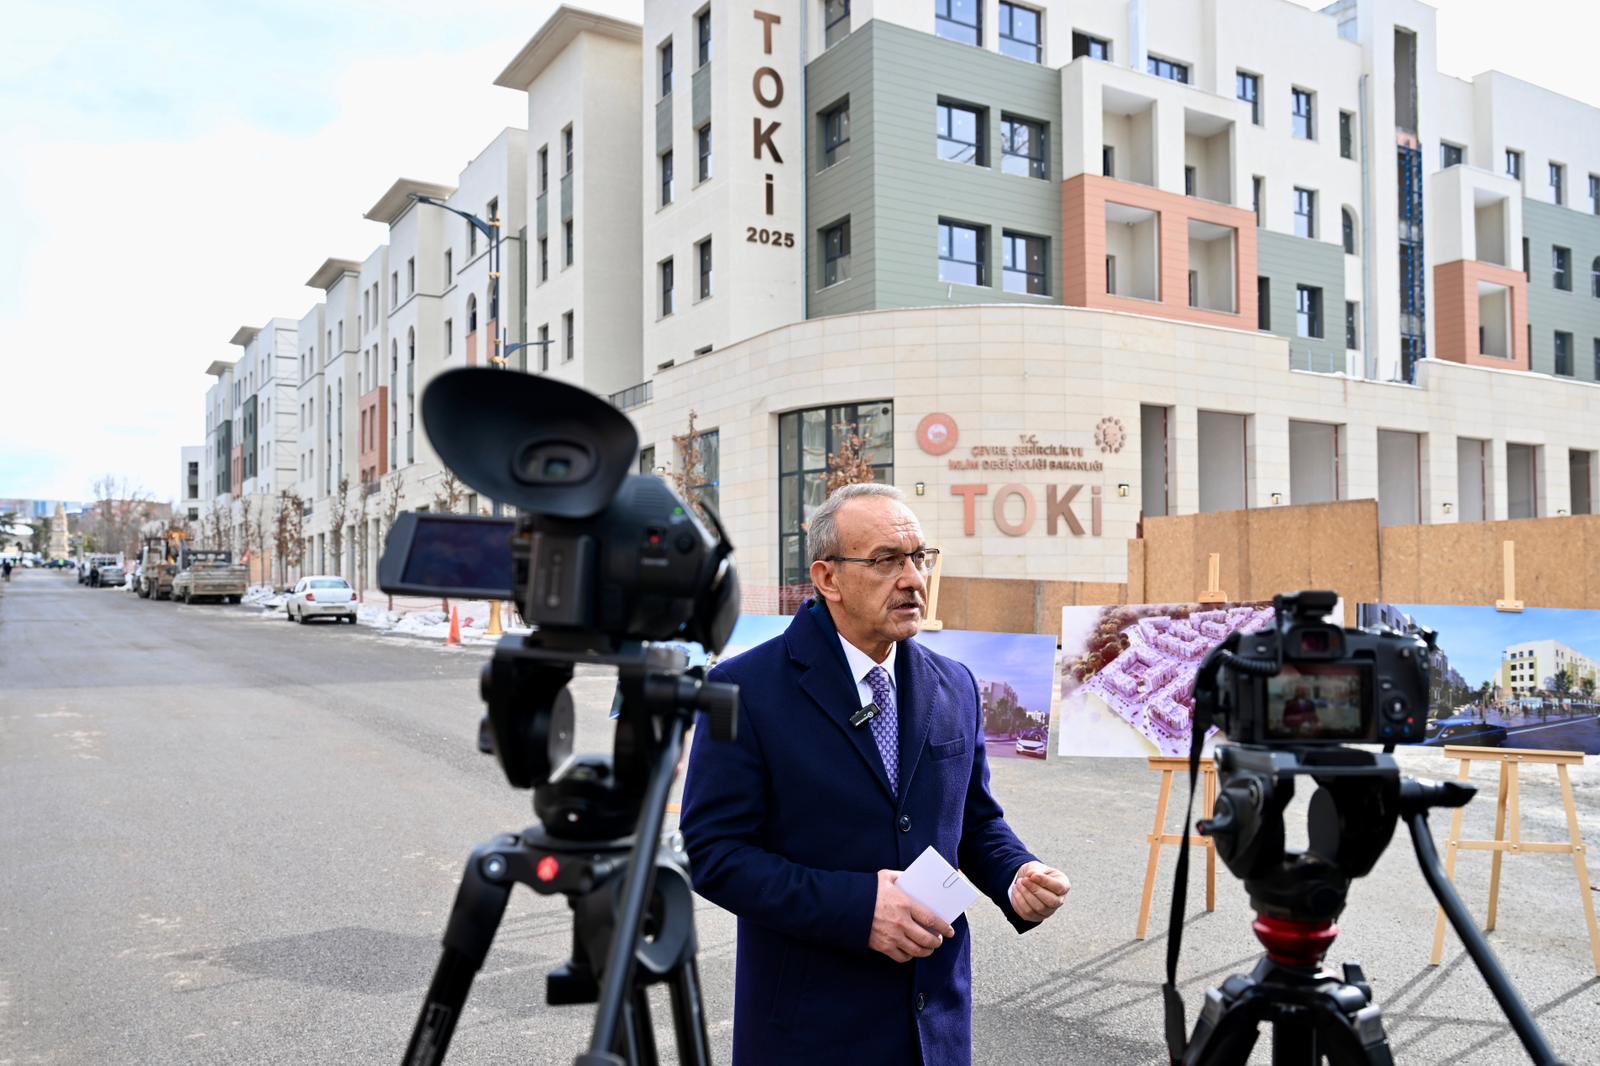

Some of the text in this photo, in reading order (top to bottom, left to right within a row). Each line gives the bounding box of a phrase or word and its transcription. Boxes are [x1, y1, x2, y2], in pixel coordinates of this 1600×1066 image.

[753, 9, 784, 216] TOKİ
[746, 227, 795, 249] 2025
[951, 483, 1102, 537] TOKİ
